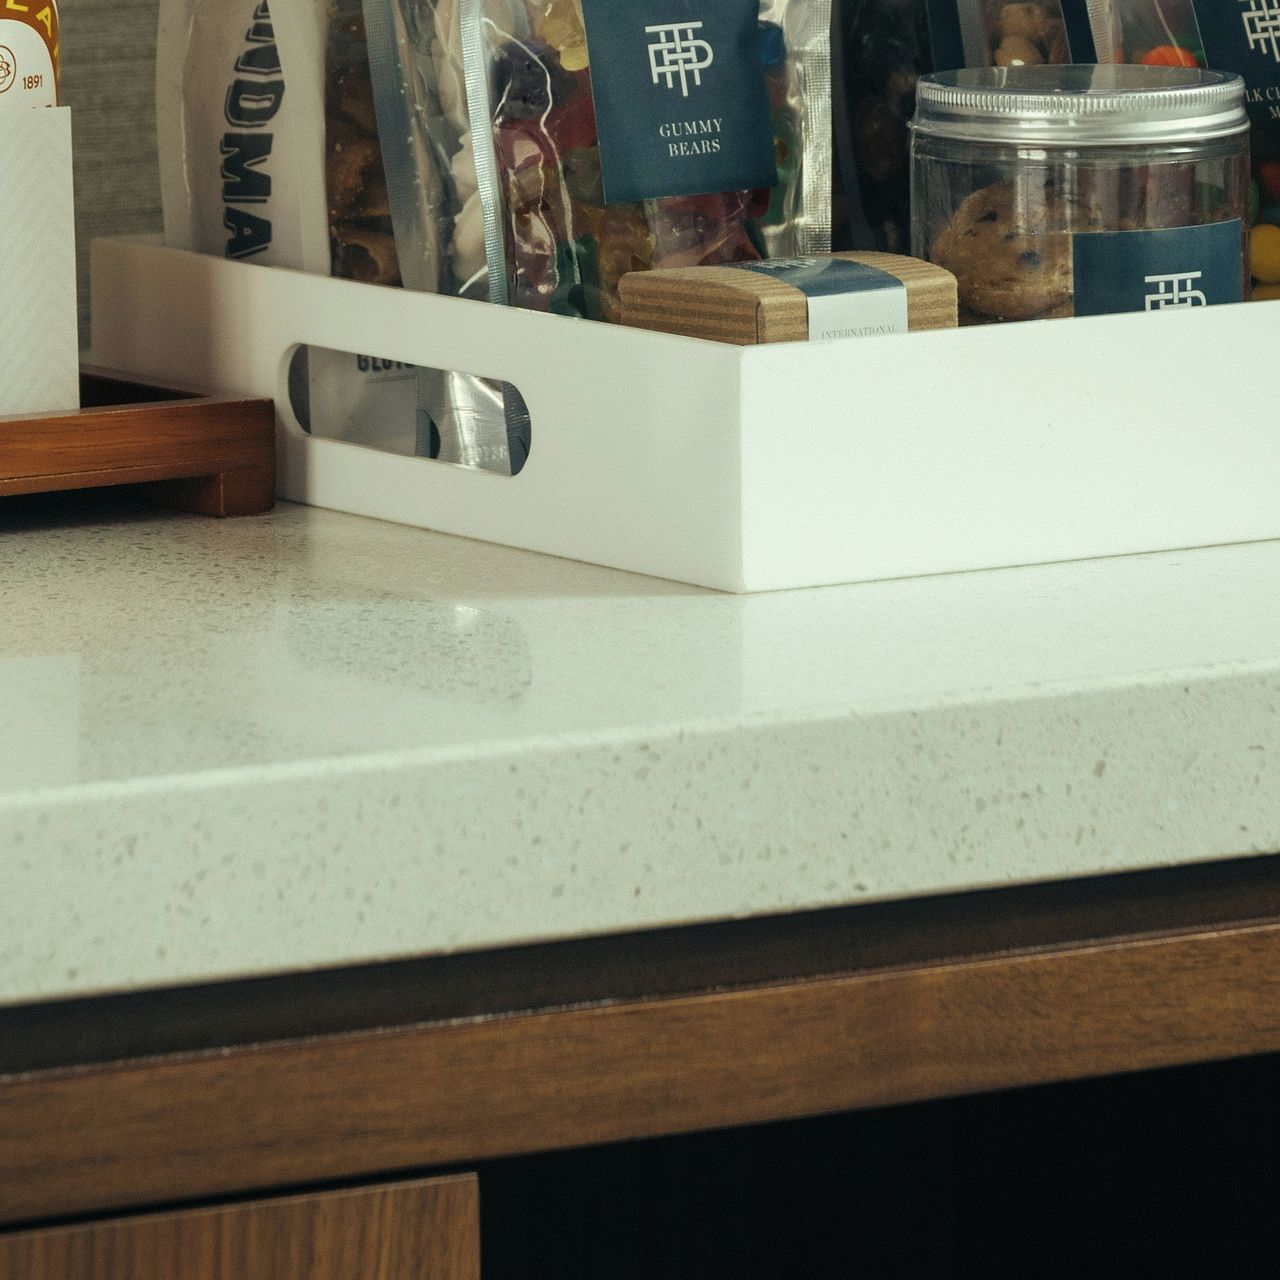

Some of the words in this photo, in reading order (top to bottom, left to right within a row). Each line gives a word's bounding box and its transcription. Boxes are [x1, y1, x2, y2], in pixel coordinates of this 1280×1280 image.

[22, 75, 44, 91] 1891
[1246, 89, 1265, 103] LK
[658, 118, 724, 138] GUMMY
[668, 138, 722, 158] BEARS
[821, 324, 897, 341] INTERNATIONAL
